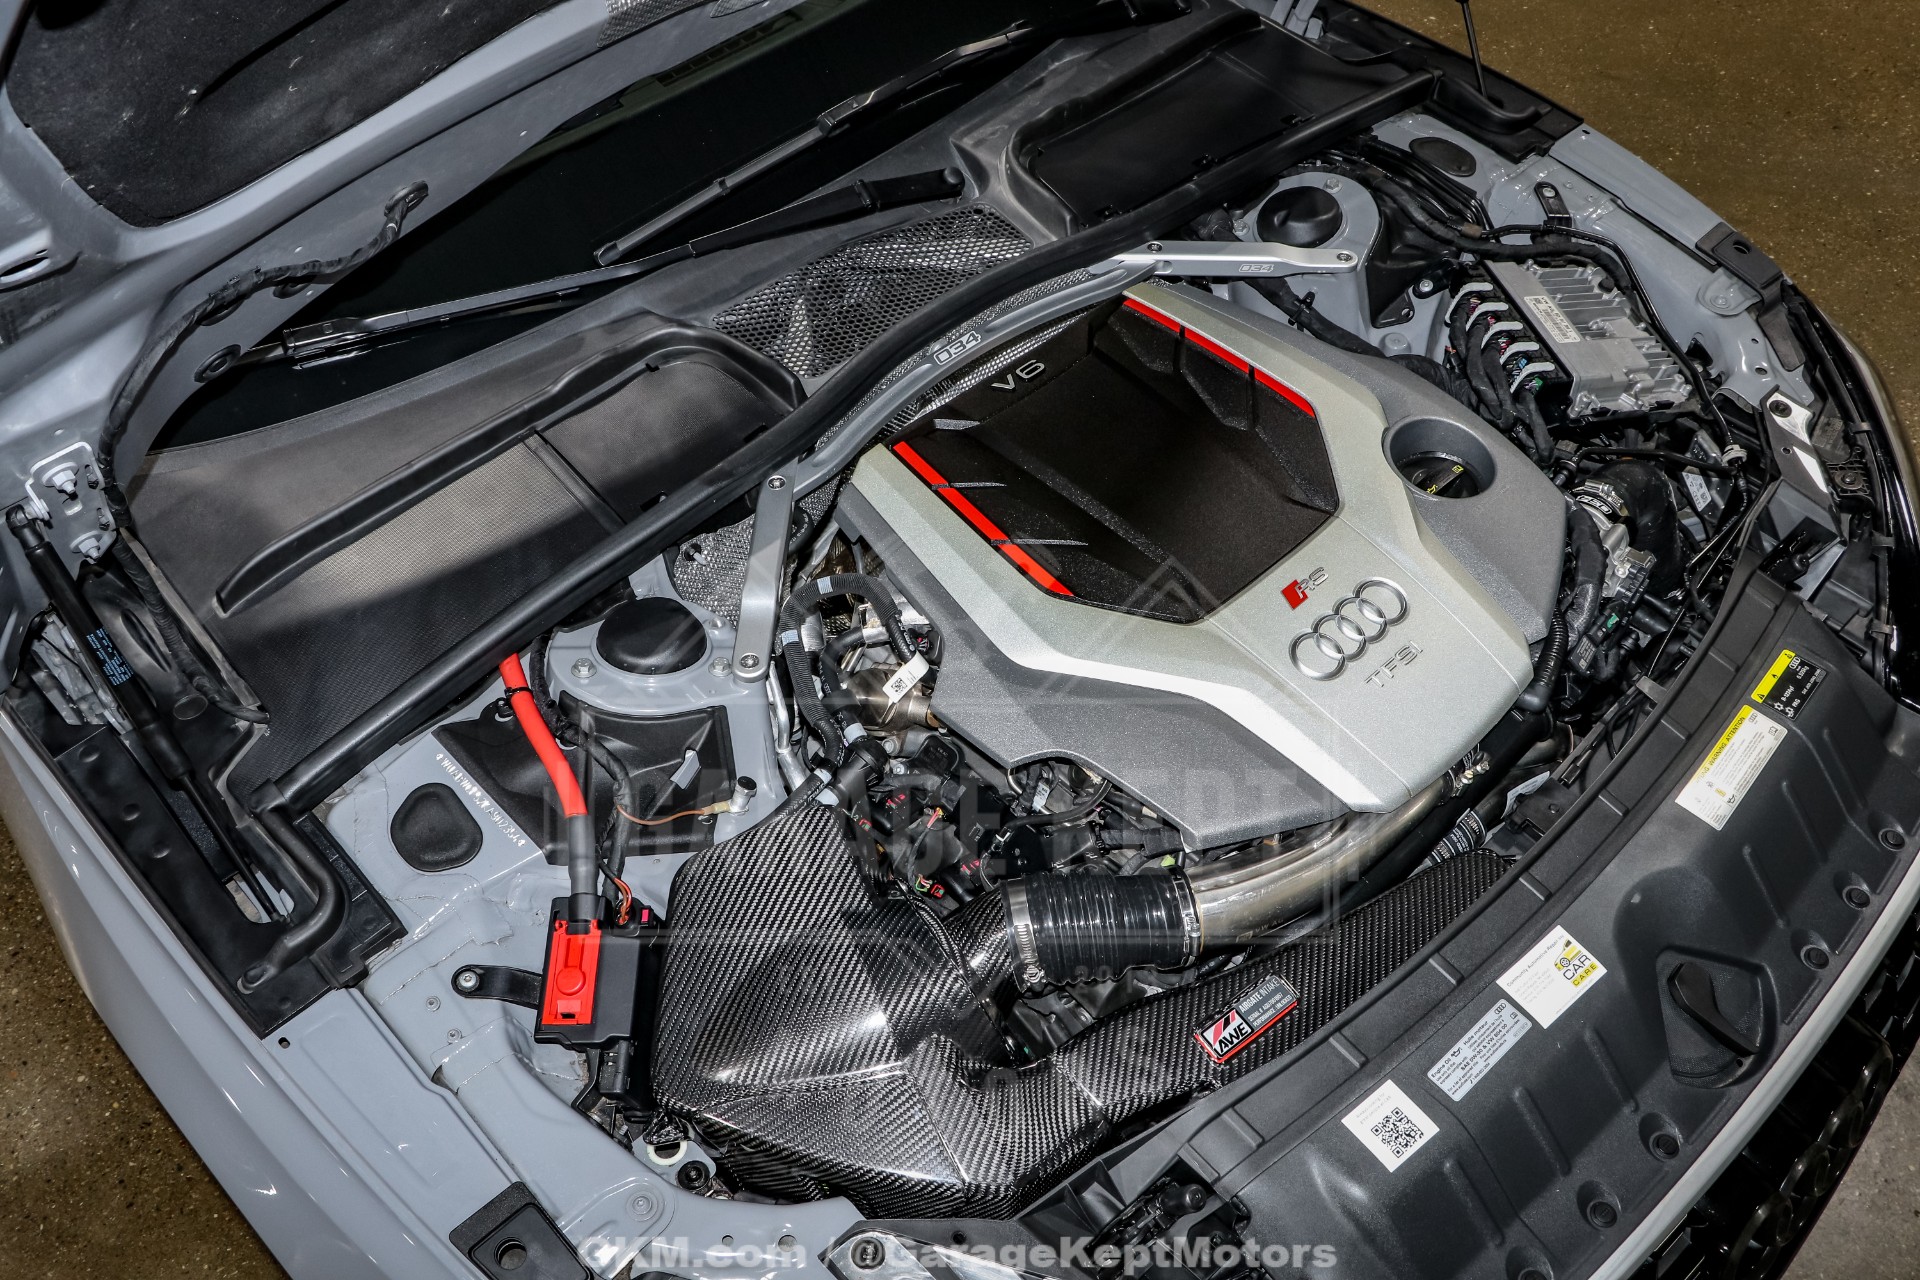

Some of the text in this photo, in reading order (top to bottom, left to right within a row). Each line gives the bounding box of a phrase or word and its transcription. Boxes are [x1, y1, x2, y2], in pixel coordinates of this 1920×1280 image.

[1239, 263, 1275, 273] 034
[933, 330, 982, 366] 034
[990, 359, 1046, 391] V6
[1363, 640, 1424, 688] TFSI
[1708, 742, 1727, 766] WARNING
[1725, 716, 1745, 742] ATTENTION
[1563, 954, 1591, 981] CAR
[1573, 963, 1598, 986] CARE
[1239, 978, 1281, 1014] AIRGATE INTAKE
[1217, 1022, 1249, 1053] AWE
[1463, 1020, 1489, 1045] Huile moteur
[1461, 1061, 1470, 1071] SAE
[1486, 1037, 1495, 1045] VW
[1431, 1064, 1446, 1078] Engine
